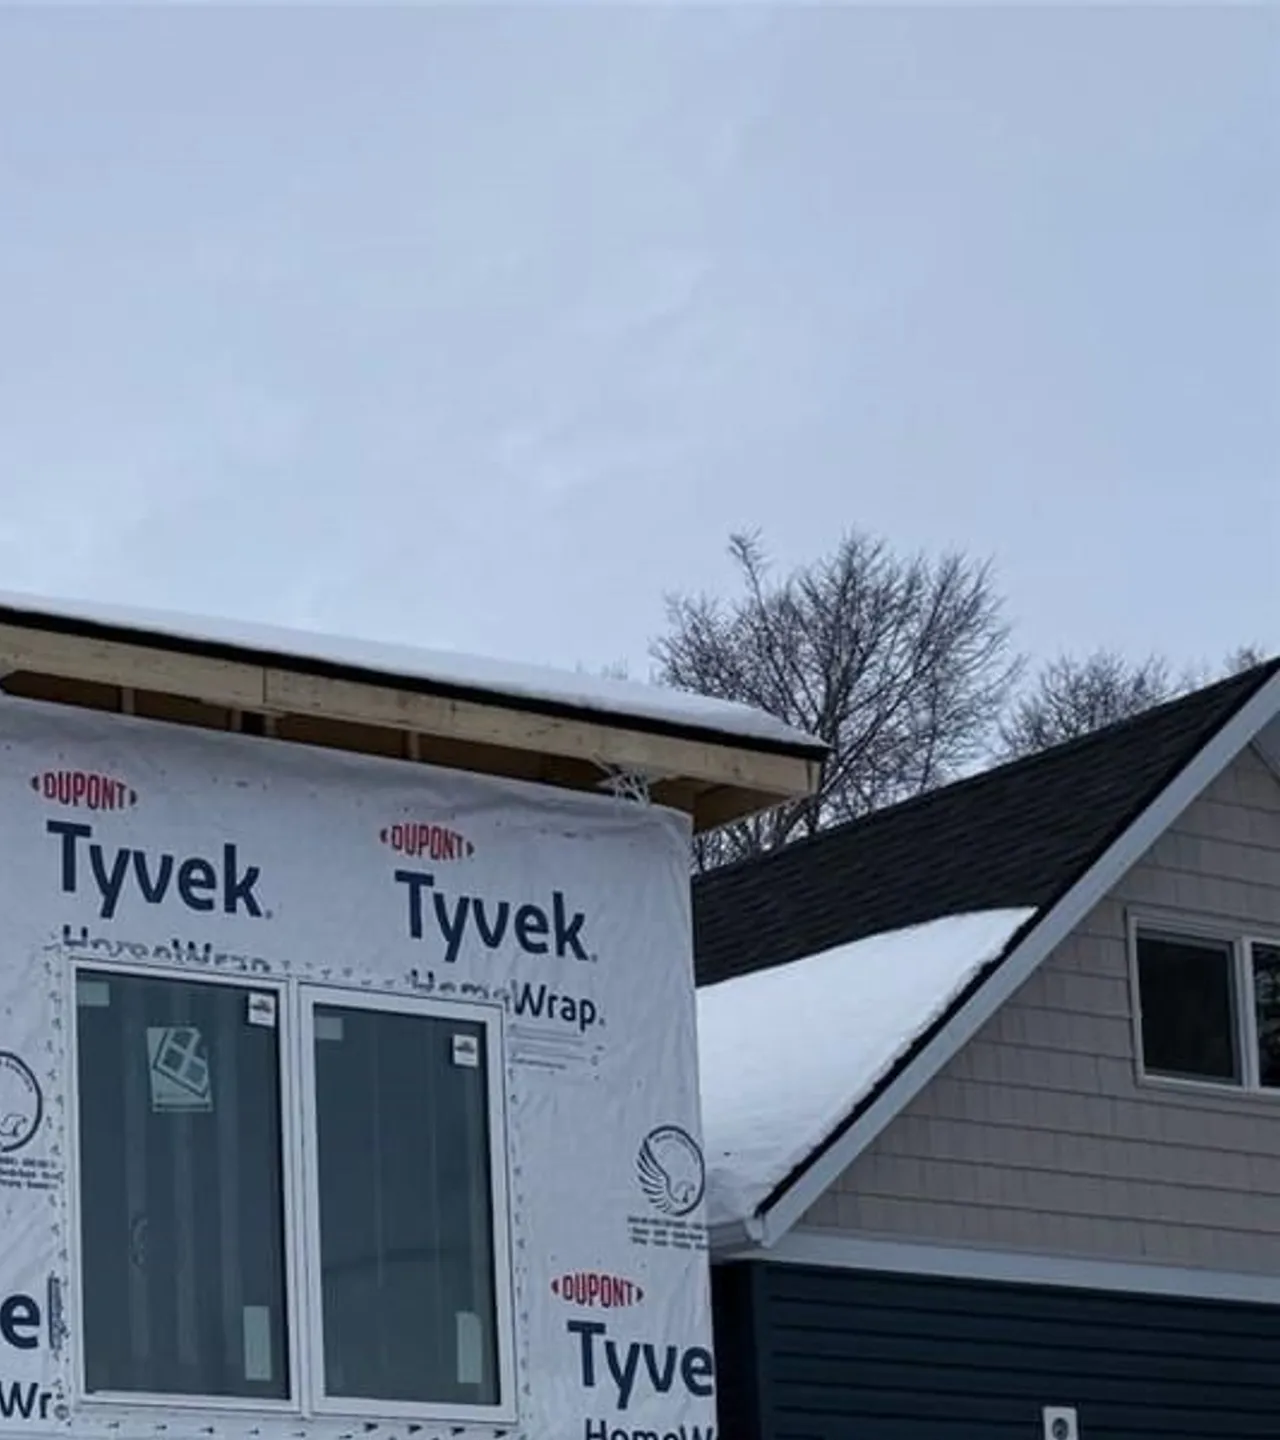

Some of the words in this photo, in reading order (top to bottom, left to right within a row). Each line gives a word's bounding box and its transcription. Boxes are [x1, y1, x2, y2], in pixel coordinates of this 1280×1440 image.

[43, 772, 127, 809] DUPONT
[390, 824, 466, 860] DUPONT
[46, 820, 263, 919] Tyvek
[394, 870, 588, 963] Tyvek
[563, 1273, 633, 1308] DUPONT
